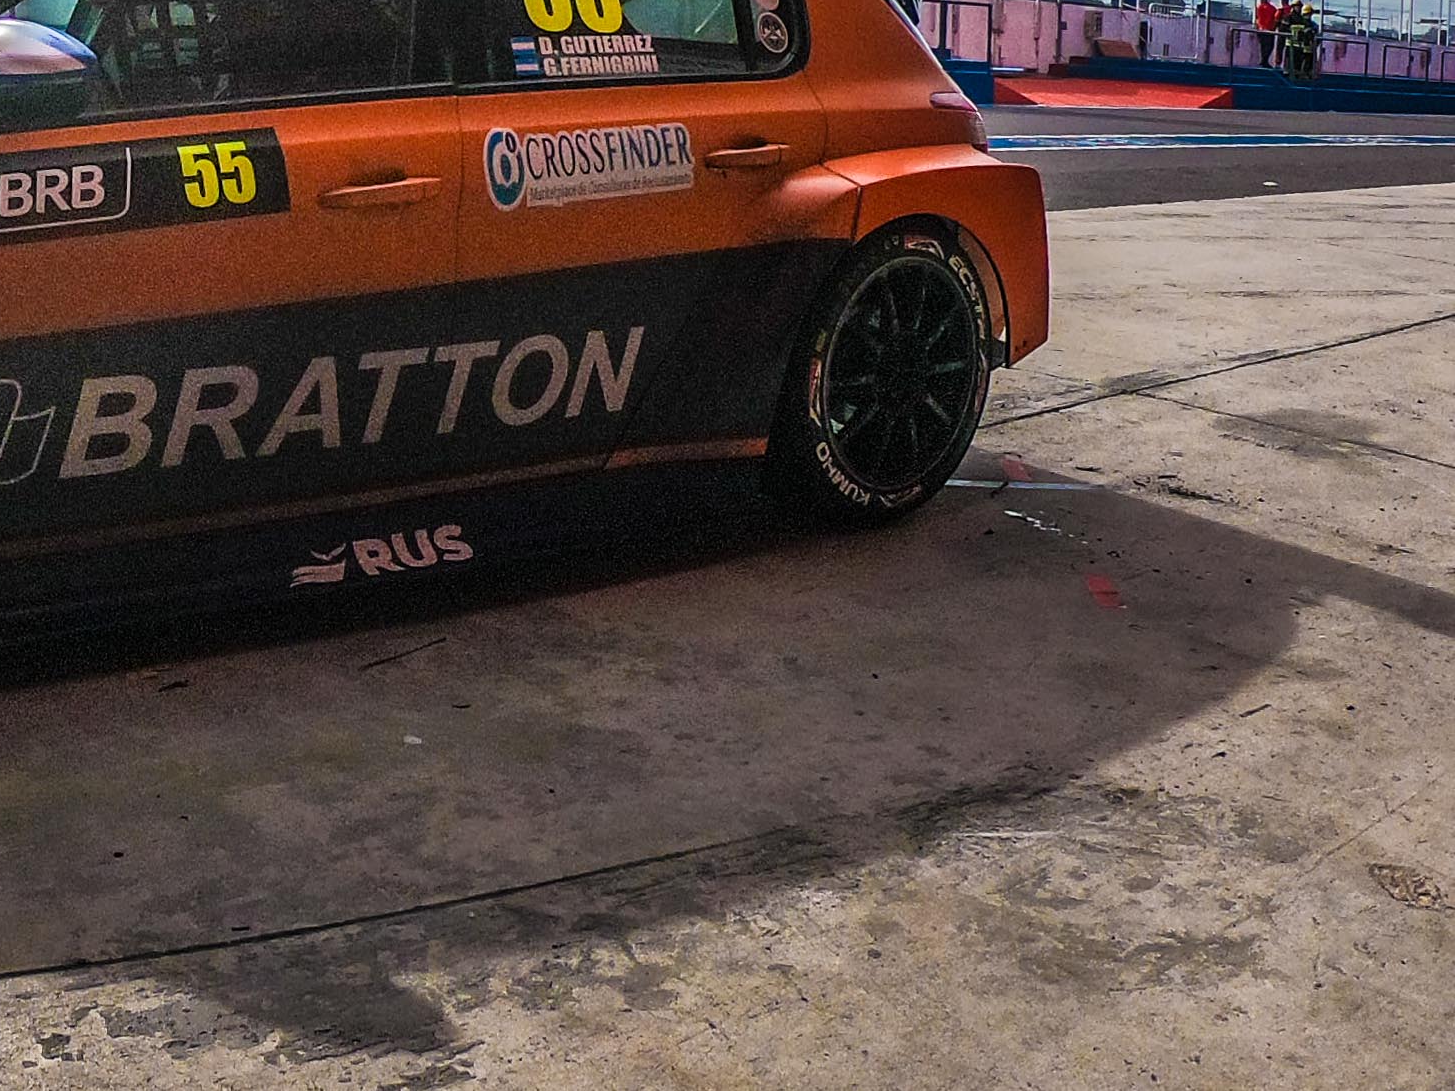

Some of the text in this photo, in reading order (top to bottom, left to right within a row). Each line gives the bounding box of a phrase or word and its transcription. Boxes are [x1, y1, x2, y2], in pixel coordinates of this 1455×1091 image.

[560, 34, 655, 54] GUTIERREZ
[176, 141, 257, 208] 55
[525, 126, 692, 180] CROSSFINDER
[58, 326, 644, 479] BRATTON
[815, 441, 872, 507] KUMHO
[353, 524, 474, 577] RUS
